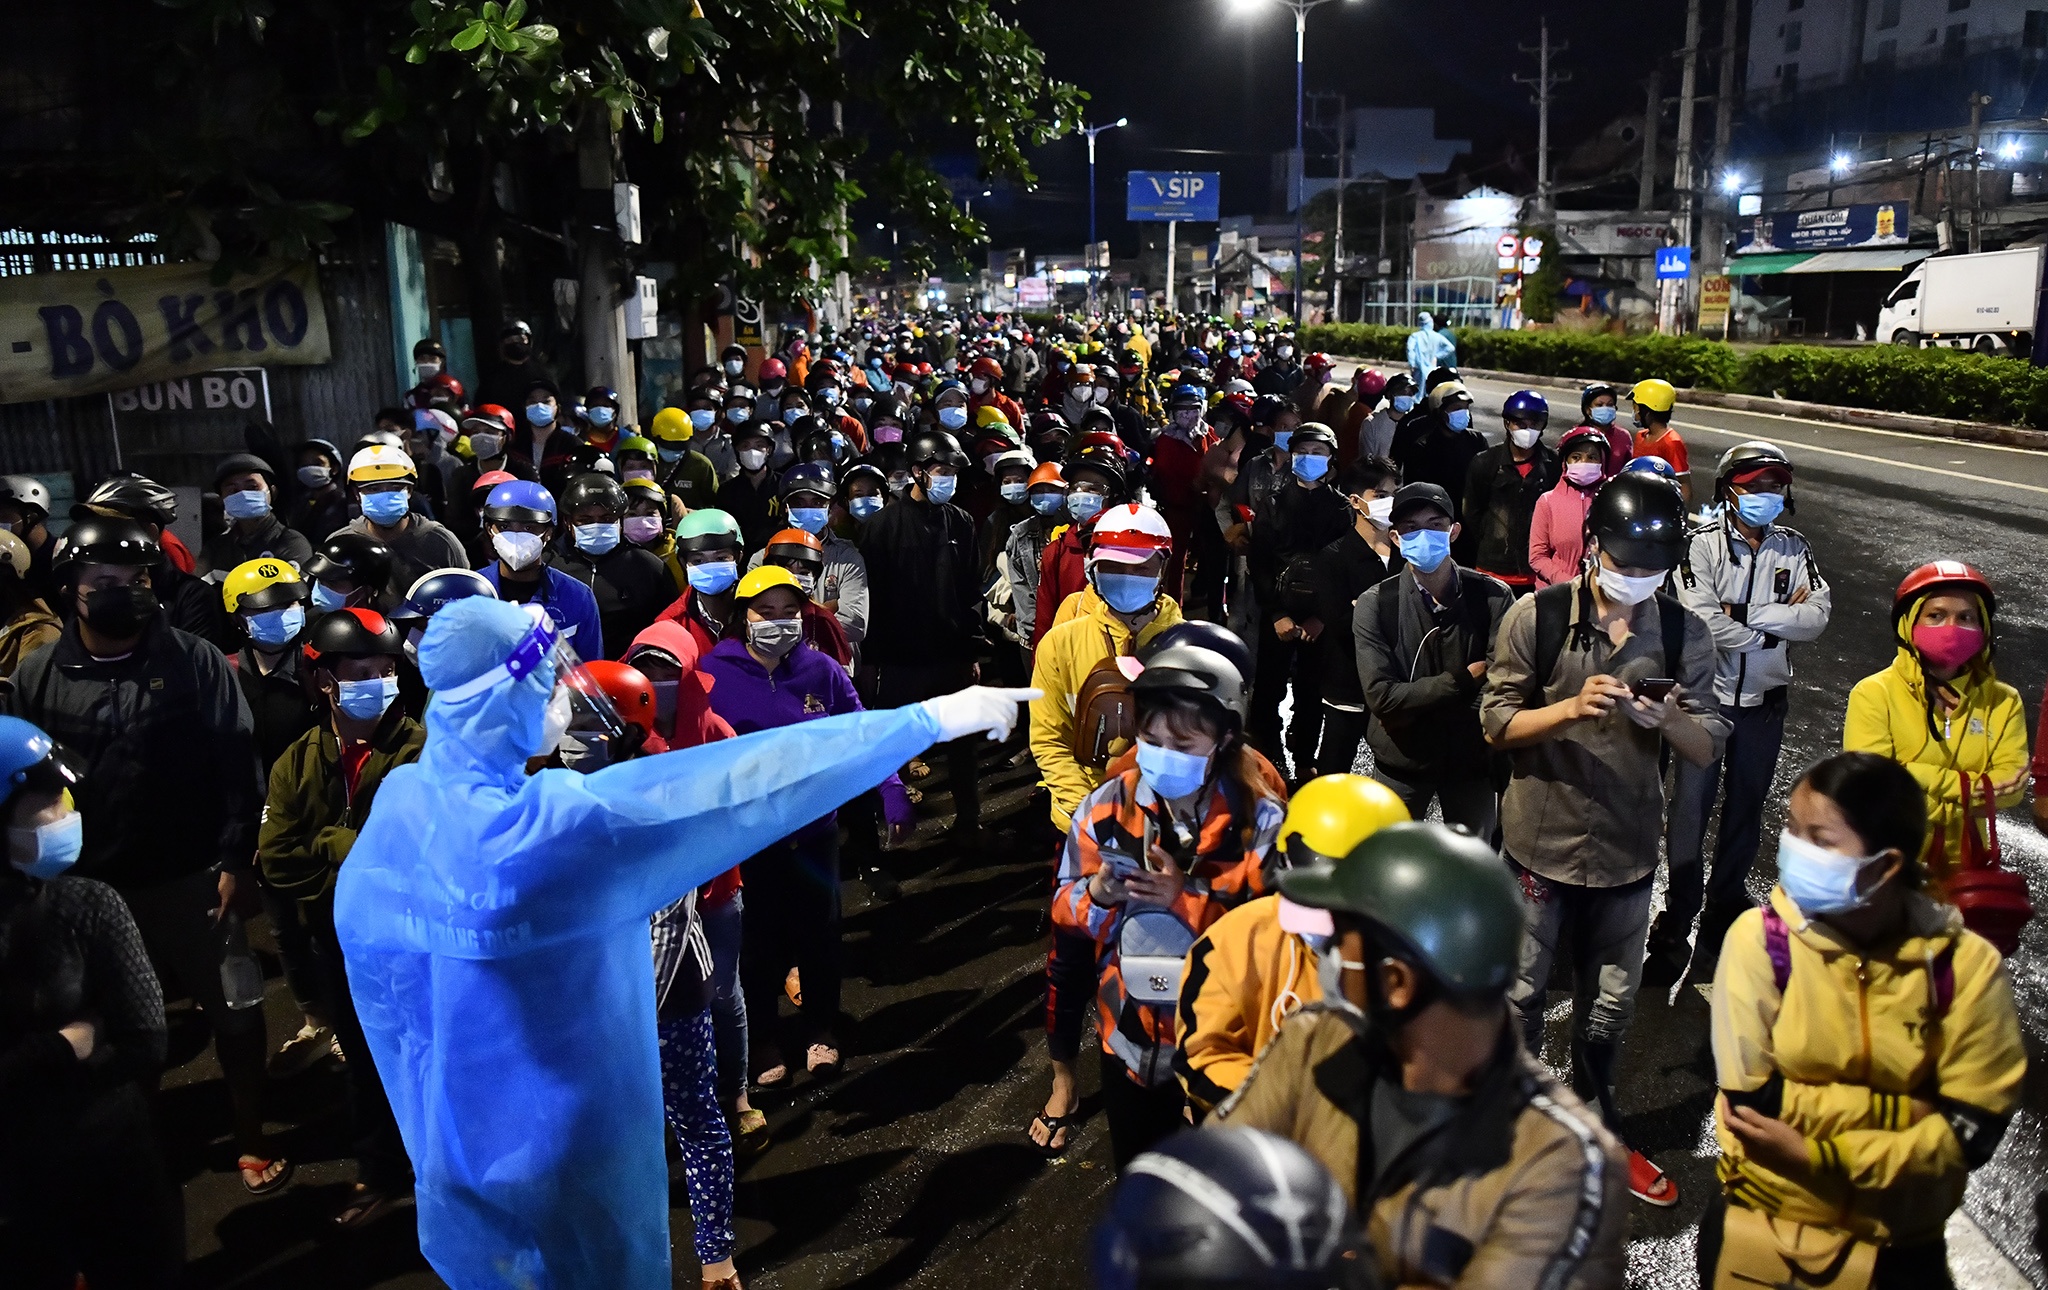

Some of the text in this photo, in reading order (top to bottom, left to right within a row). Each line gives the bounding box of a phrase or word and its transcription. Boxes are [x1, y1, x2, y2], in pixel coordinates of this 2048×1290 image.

[38, 278, 143, 379] BÒ
[158, 279, 309, 363] KHO
[202, 370, 257, 410] BÒ
[673, 480, 693, 489] VANS
